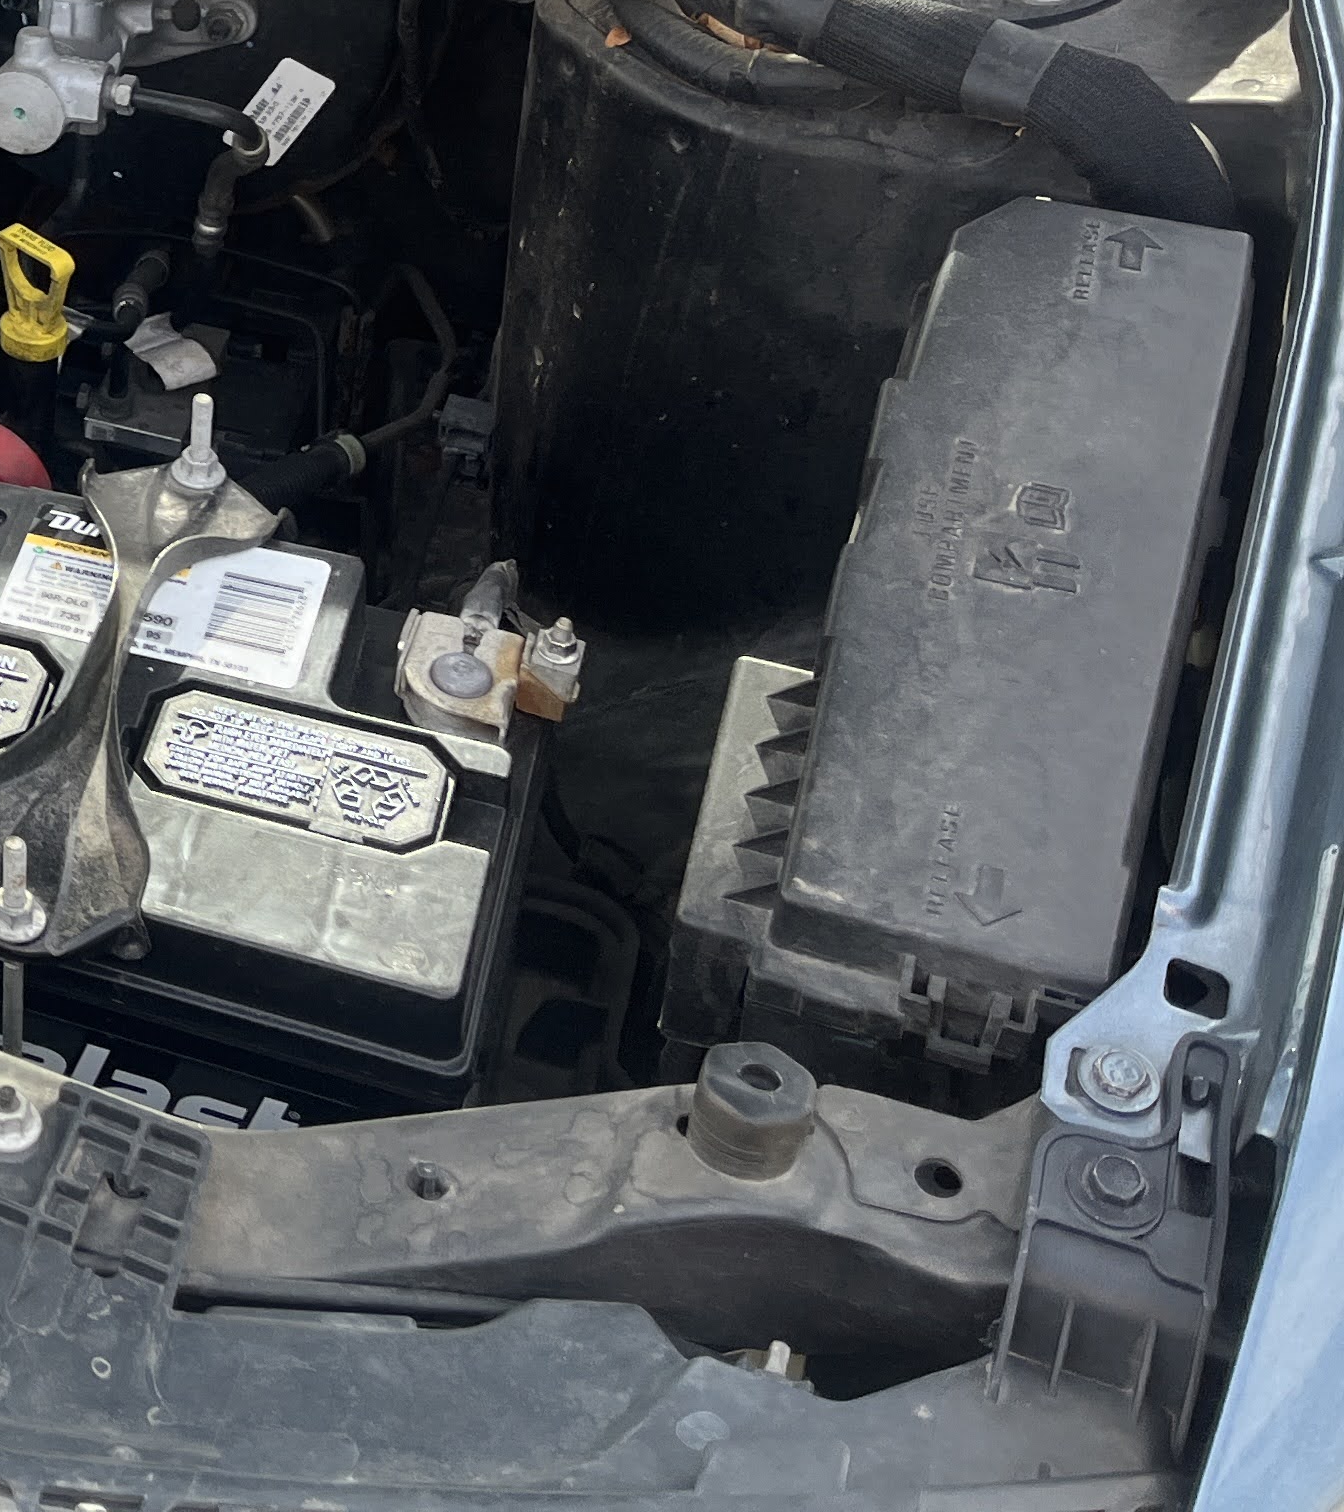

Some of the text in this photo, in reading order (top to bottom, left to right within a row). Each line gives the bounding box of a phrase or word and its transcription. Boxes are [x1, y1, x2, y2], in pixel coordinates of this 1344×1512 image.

[1073, 220, 1101, 300] RELEASE
[213, 723, 243, 737] FLUSH
[244, 731, 268, 744] EYES
[361, 747, 383, 759] AND
[926, 804, 962, 916] RELEASE
